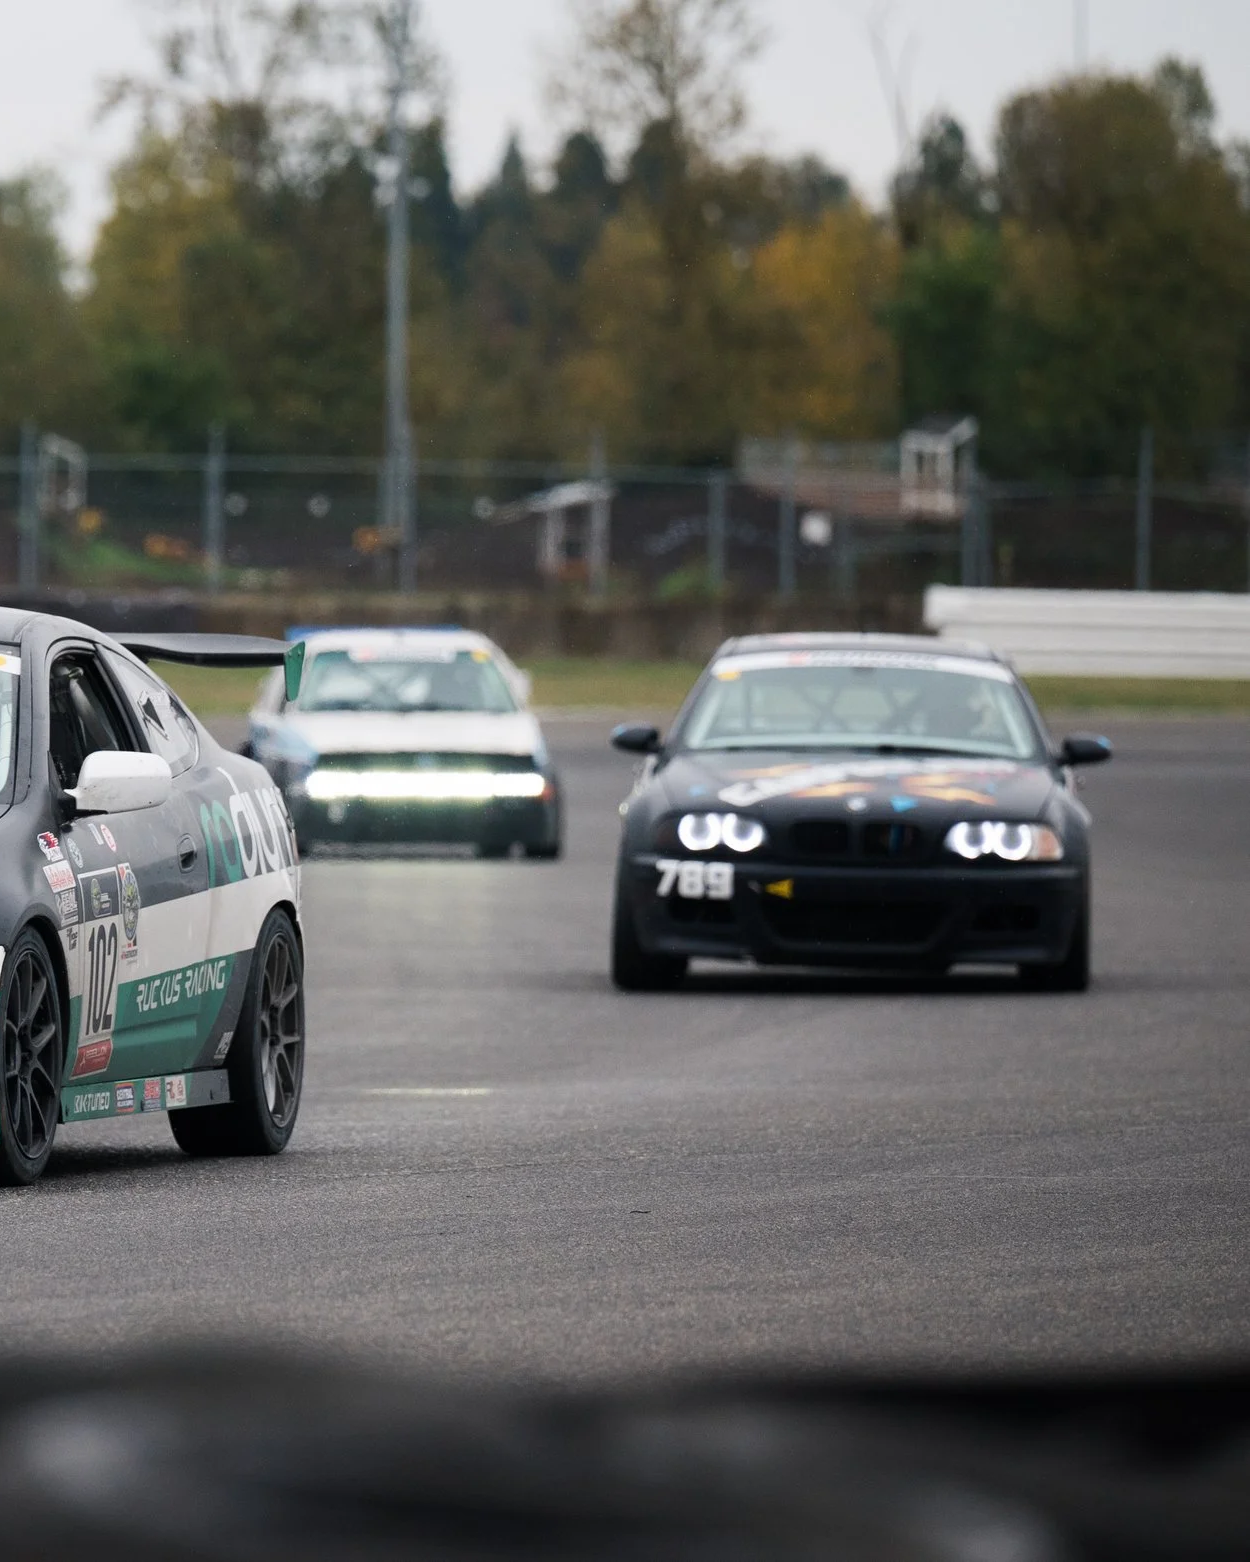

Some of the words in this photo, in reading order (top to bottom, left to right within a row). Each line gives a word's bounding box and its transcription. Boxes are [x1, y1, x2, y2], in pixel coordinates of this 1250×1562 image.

[655, 859, 735, 899] 789
[85, 922, 118, 1036] 102
[136, 972, 182, 1013] RUCKUS
[185, 960, 227, 998] RACING
[78, 1092, 110, 1112] K-TUNED
